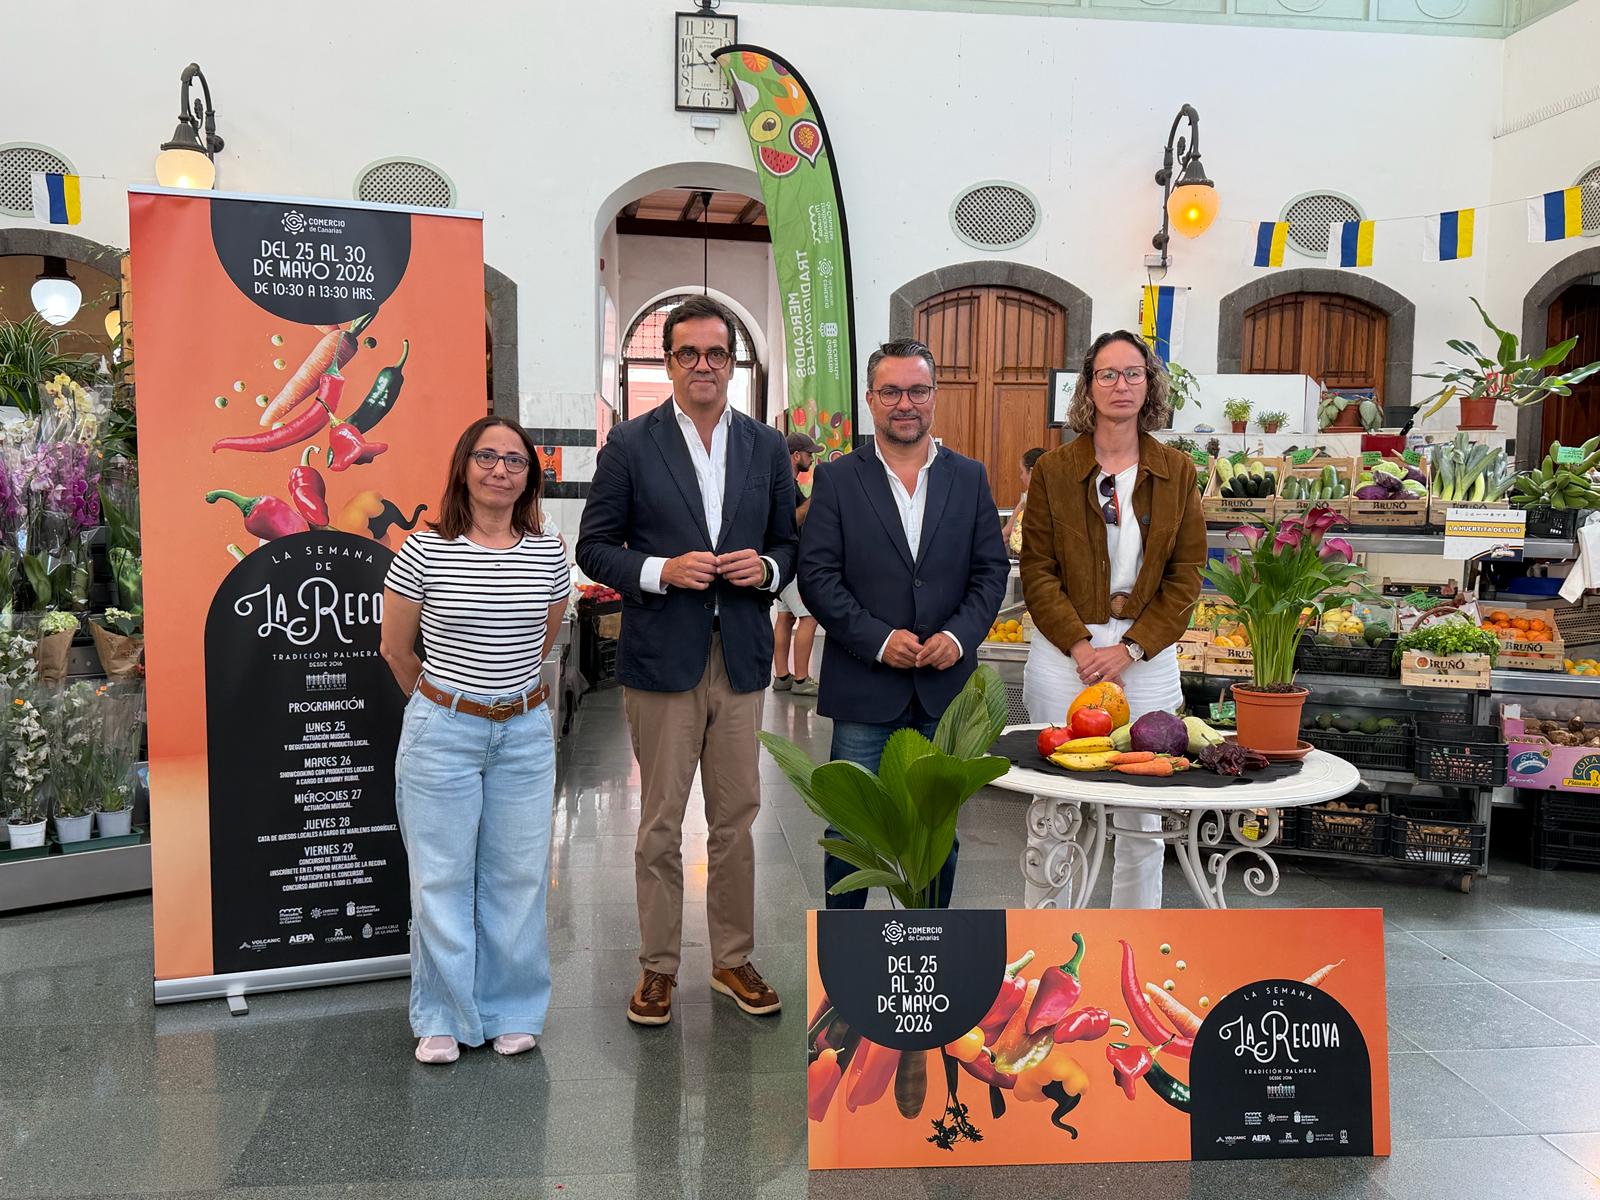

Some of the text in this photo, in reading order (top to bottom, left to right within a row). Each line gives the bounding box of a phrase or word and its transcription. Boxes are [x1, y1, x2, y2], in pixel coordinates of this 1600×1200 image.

[685, 20, 694, 36] 11
[702, 20, 714, 35] 12
[680, 38, 692, 52] 10
[682, 70, 690, 88] 8
[684, 88, 692, 104] 7
[702, 91, 710, 107] 6
[308, 218, 346, 228] COMERCIO
[262, 240, 366, 263] DEL 25 AL 30
[253, 259, 375, 283] DE MAYO 2026
[254, 282, 376, 301] DE 10:30 A 13:30 HRS.
[272, 546, 373, 564] LA SEMANA
[315, 562, 332, 571] DE
[234, 577, 384, 645] LA RECO
[272, 650, 378, 661] TRADICIÓN PALMERA
[289, 696, 364, 713] PROGRAMACIÓN
[306, 720, 346, 733] LUNES 25
[289, 742, 320, 750] DEGUSTACIÓN
[304, 755, 351, 768] MARTES 26
[280, 770, 315, 779] SHOWCOOKING
[294, 789, 362, 804] MIÉRCOLES 27
[304, 817, 350, 830] JUEVES 28
[304, 843, 354, 857] VIERNES 29
[299, 873, 323, 882] PARTICIPA
[289, 933, 315, 944] AEPA
[888, 956, 938, 973] DEL 25
[892, 974, 935, 993] AL 30
[1244, 986, 1312, 1001] LA SEMANA
[878, 994, 950, 1013] DE MAYO
[895, 1014, 933, 1033] 2026
[1219, 1010, 1340, 1063] LA RECOVA
